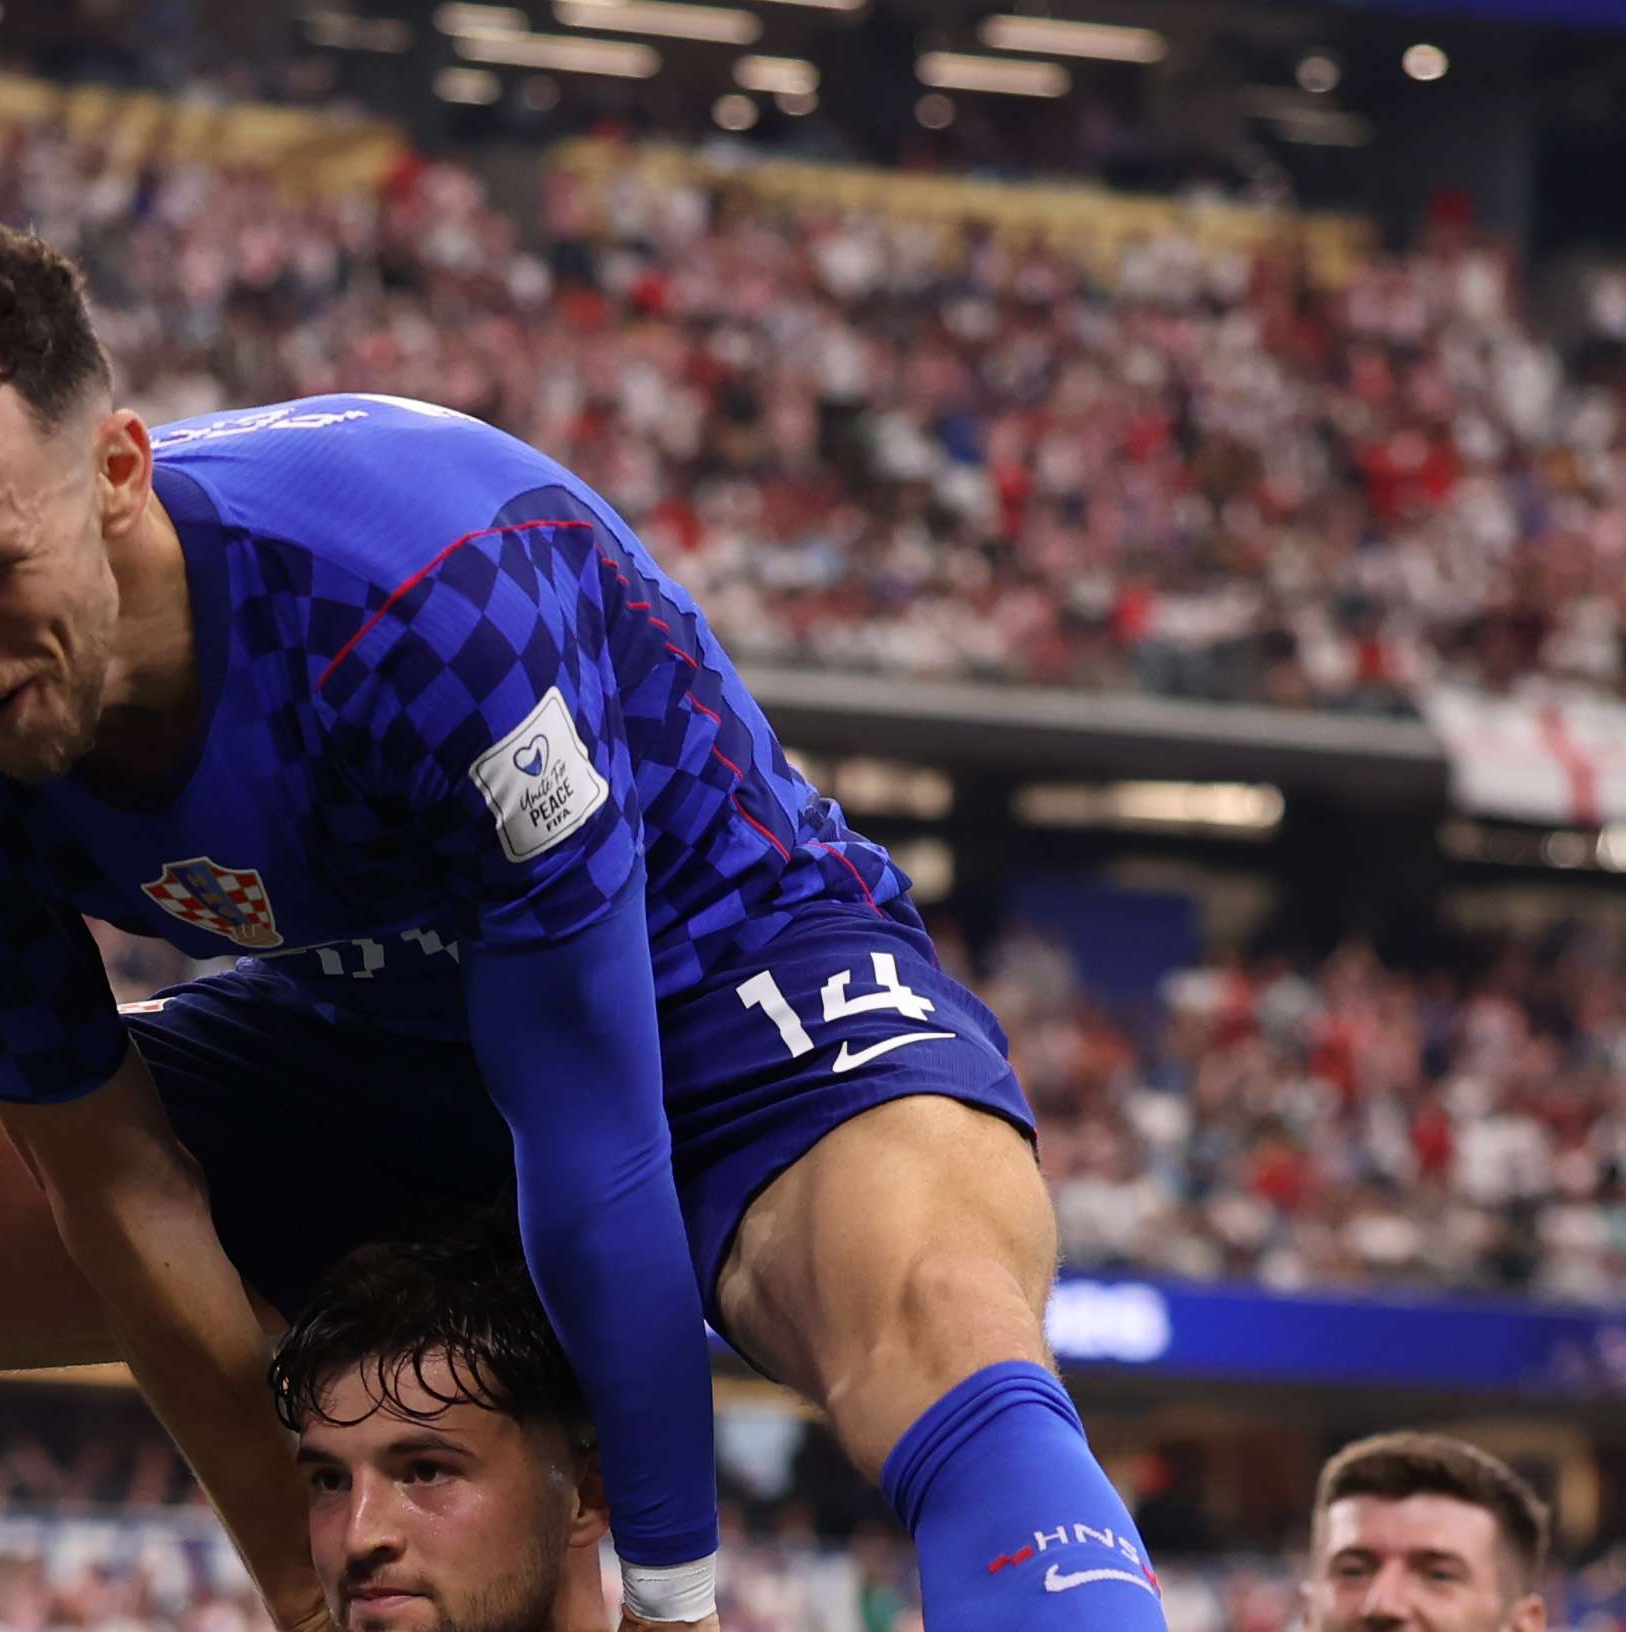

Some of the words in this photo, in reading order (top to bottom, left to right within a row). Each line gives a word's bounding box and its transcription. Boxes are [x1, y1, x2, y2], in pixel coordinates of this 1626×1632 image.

[520, 777, 552, 812] Unite
[529, 775, 574, 828] PEACE
[545, 808, 571, 832] FIFA
[734, 951, 936, 1059] 14
[1033, 1522, 1140, 1565] HNS
